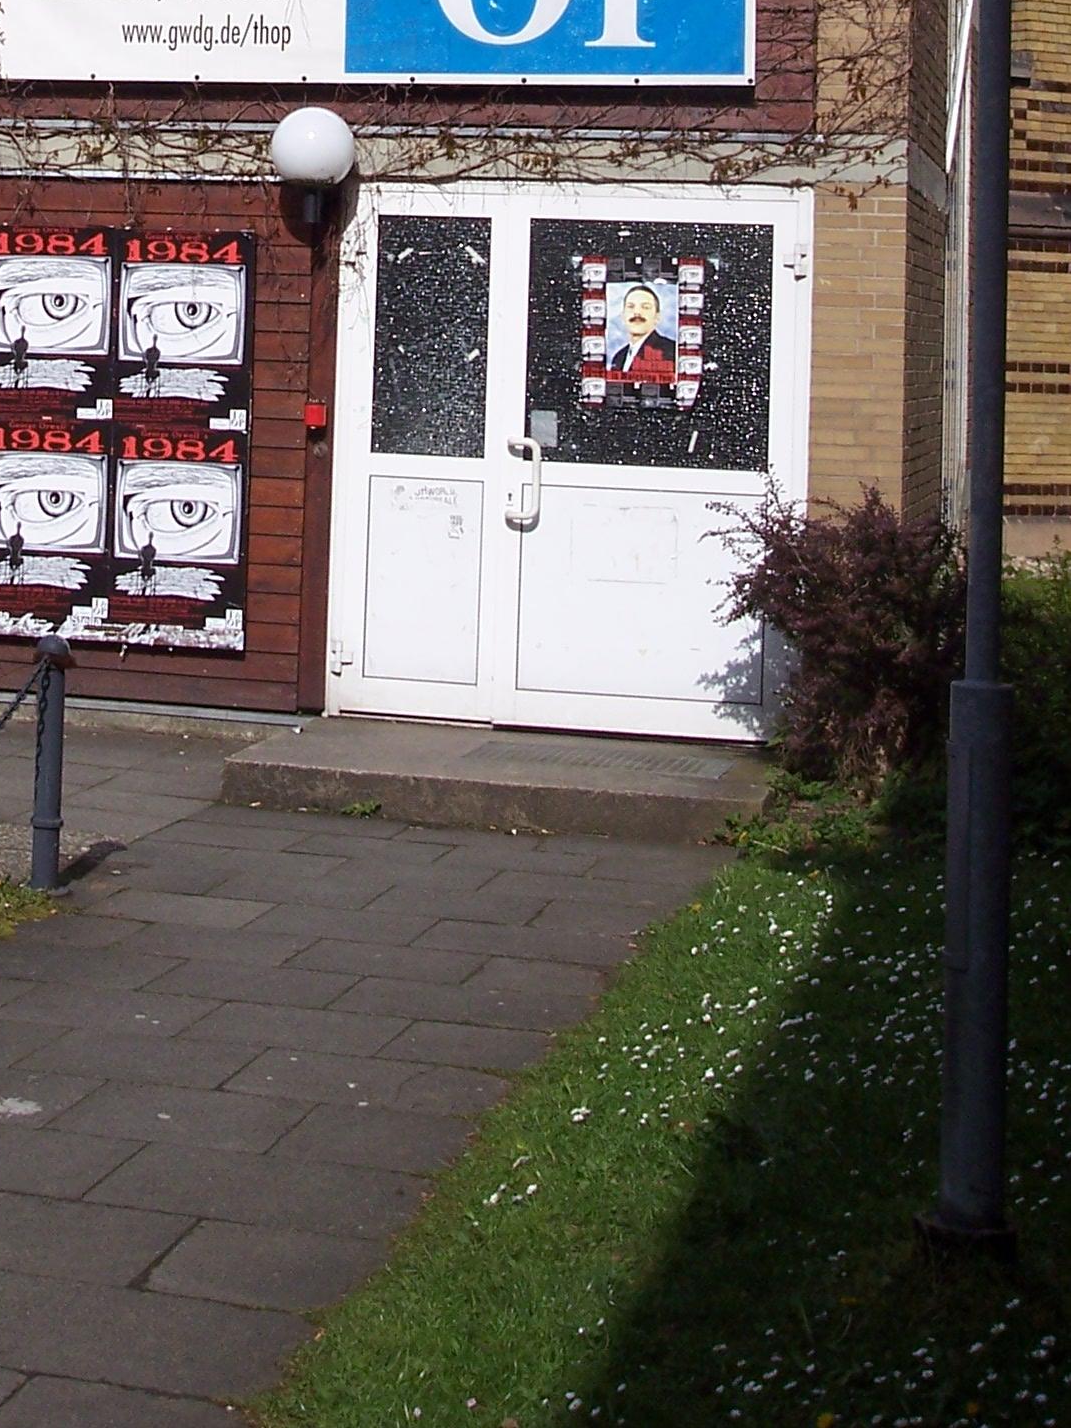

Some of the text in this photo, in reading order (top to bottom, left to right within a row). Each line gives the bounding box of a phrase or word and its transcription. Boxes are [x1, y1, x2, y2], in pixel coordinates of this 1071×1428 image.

[121, 14, 291, 51] www.gwdg.de/thop
[127, 239, 242, 263] 1984
[122, 436, 238, 461] 1984
